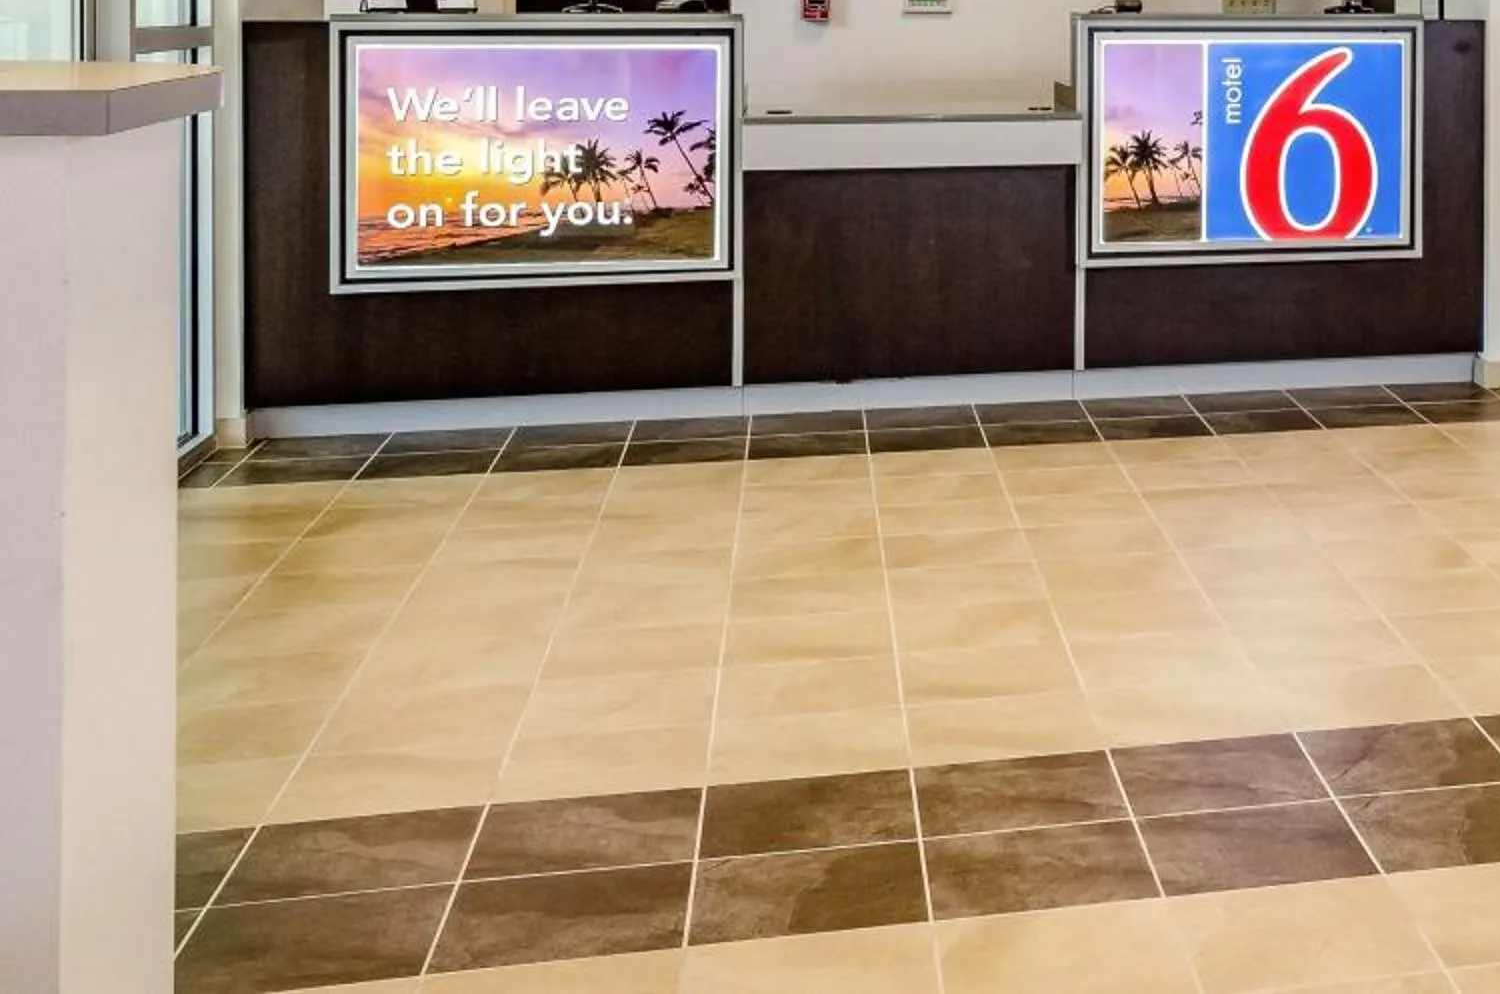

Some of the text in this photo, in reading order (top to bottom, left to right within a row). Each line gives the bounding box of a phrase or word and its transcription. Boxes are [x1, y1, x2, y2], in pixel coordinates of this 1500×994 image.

[386, 85, 630, 123] We'll leave
[386, 138, 584, 185] the light
[1221, 46, 1379, 242] motel 6
[386, 190, 634, 237] on for you.
